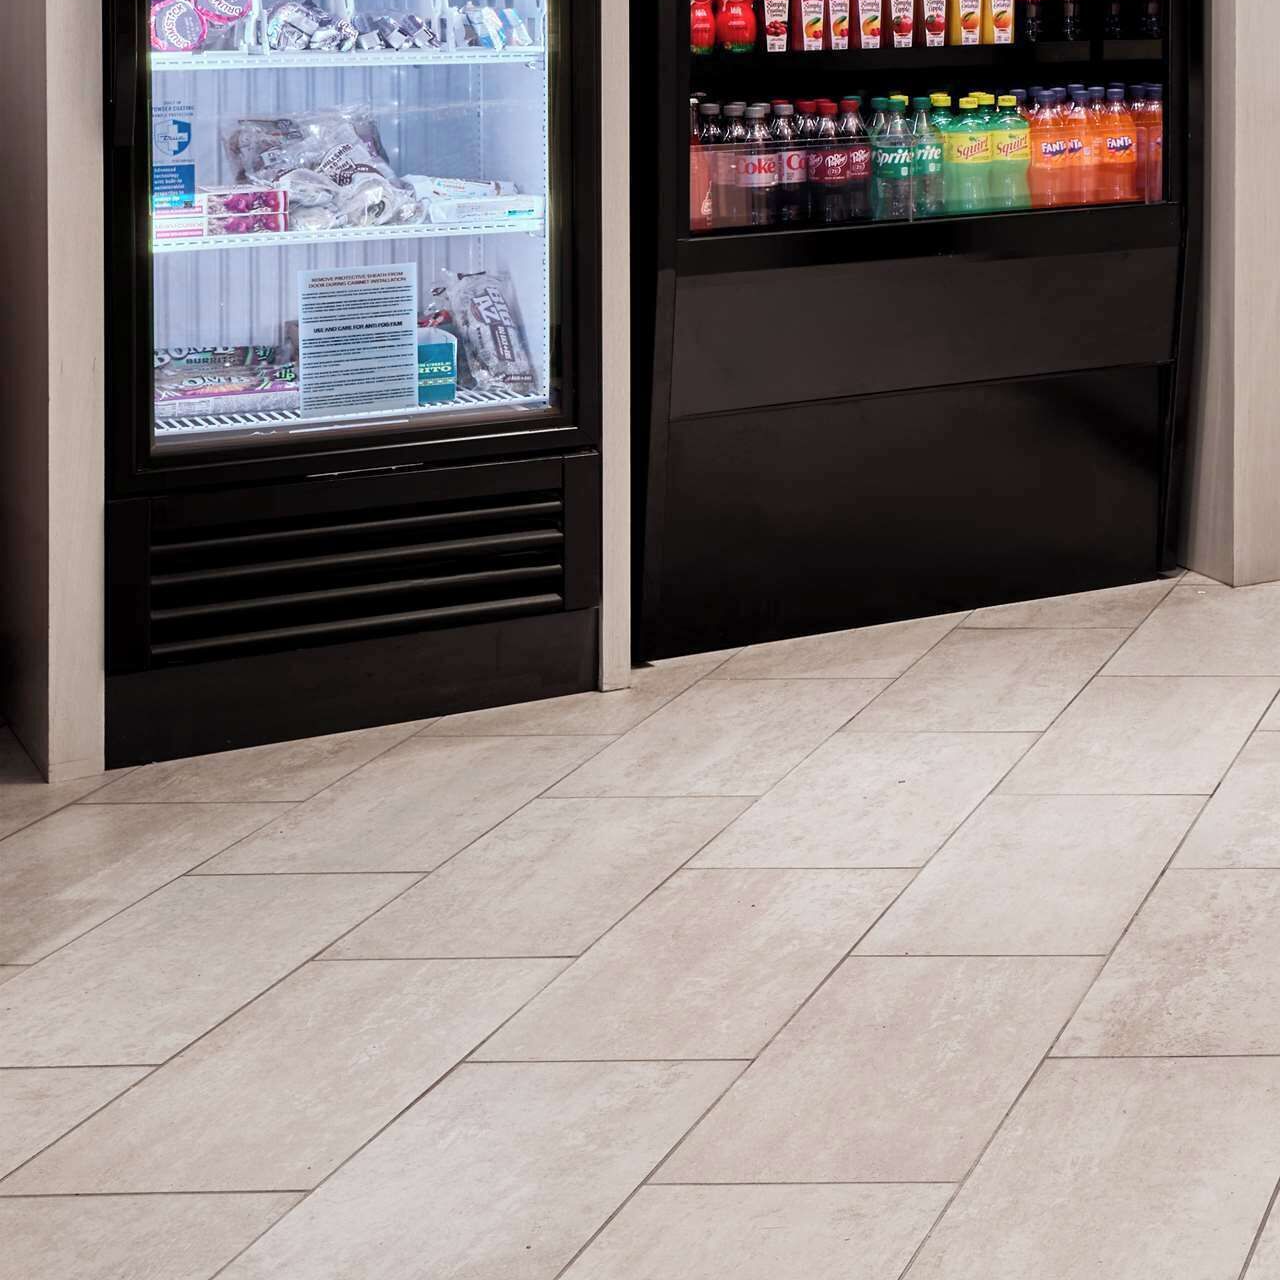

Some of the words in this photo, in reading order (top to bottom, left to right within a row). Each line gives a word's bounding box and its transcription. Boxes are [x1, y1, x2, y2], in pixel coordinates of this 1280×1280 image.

[877, 145, 914, 166] Sprite
[916, 145, 942, 160] rite
[957, 136, 989, 160] Squirt
[997, 134, 1028, 157] Squirt
